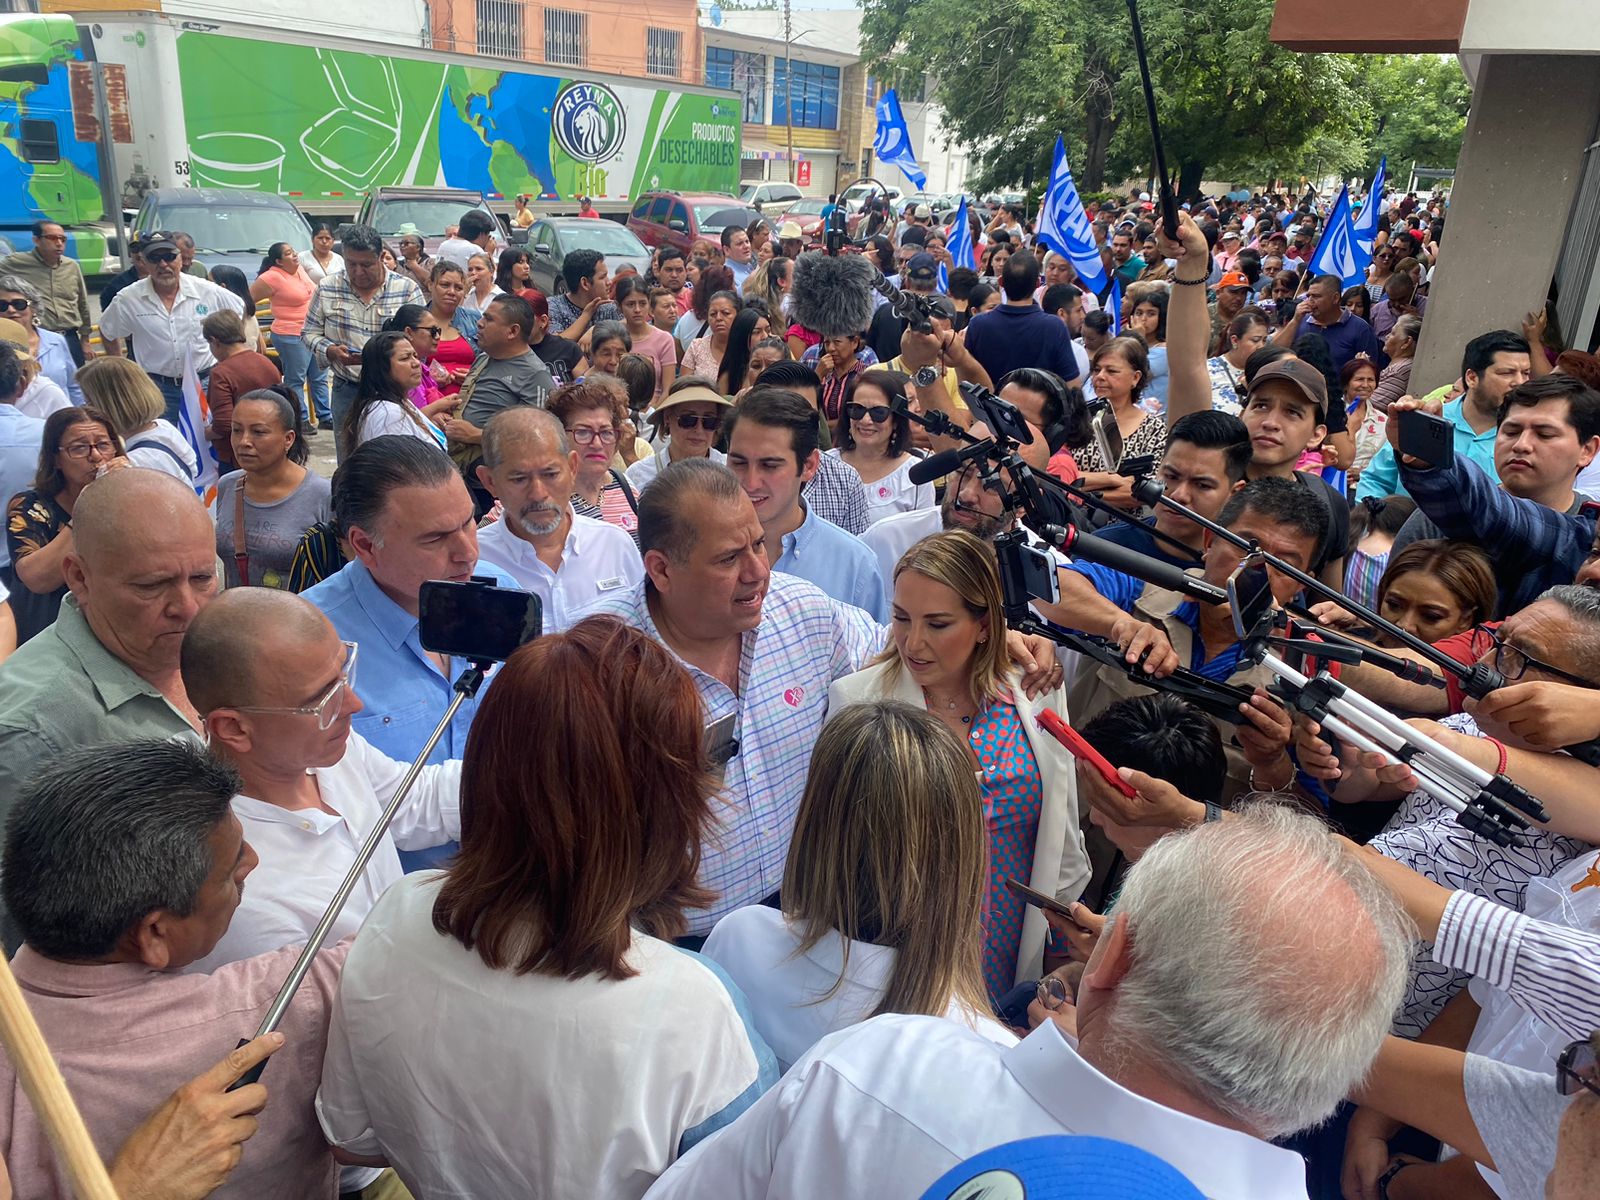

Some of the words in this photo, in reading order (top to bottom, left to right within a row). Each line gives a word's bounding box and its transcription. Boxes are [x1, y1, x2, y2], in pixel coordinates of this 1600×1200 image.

[563, 86, 614, 116] REYMA
[692, 121, 736, 143] PRODUCTOS
[659, 138, 735, 167] DESECHABLES
[175, 160, 190, 175] 53
